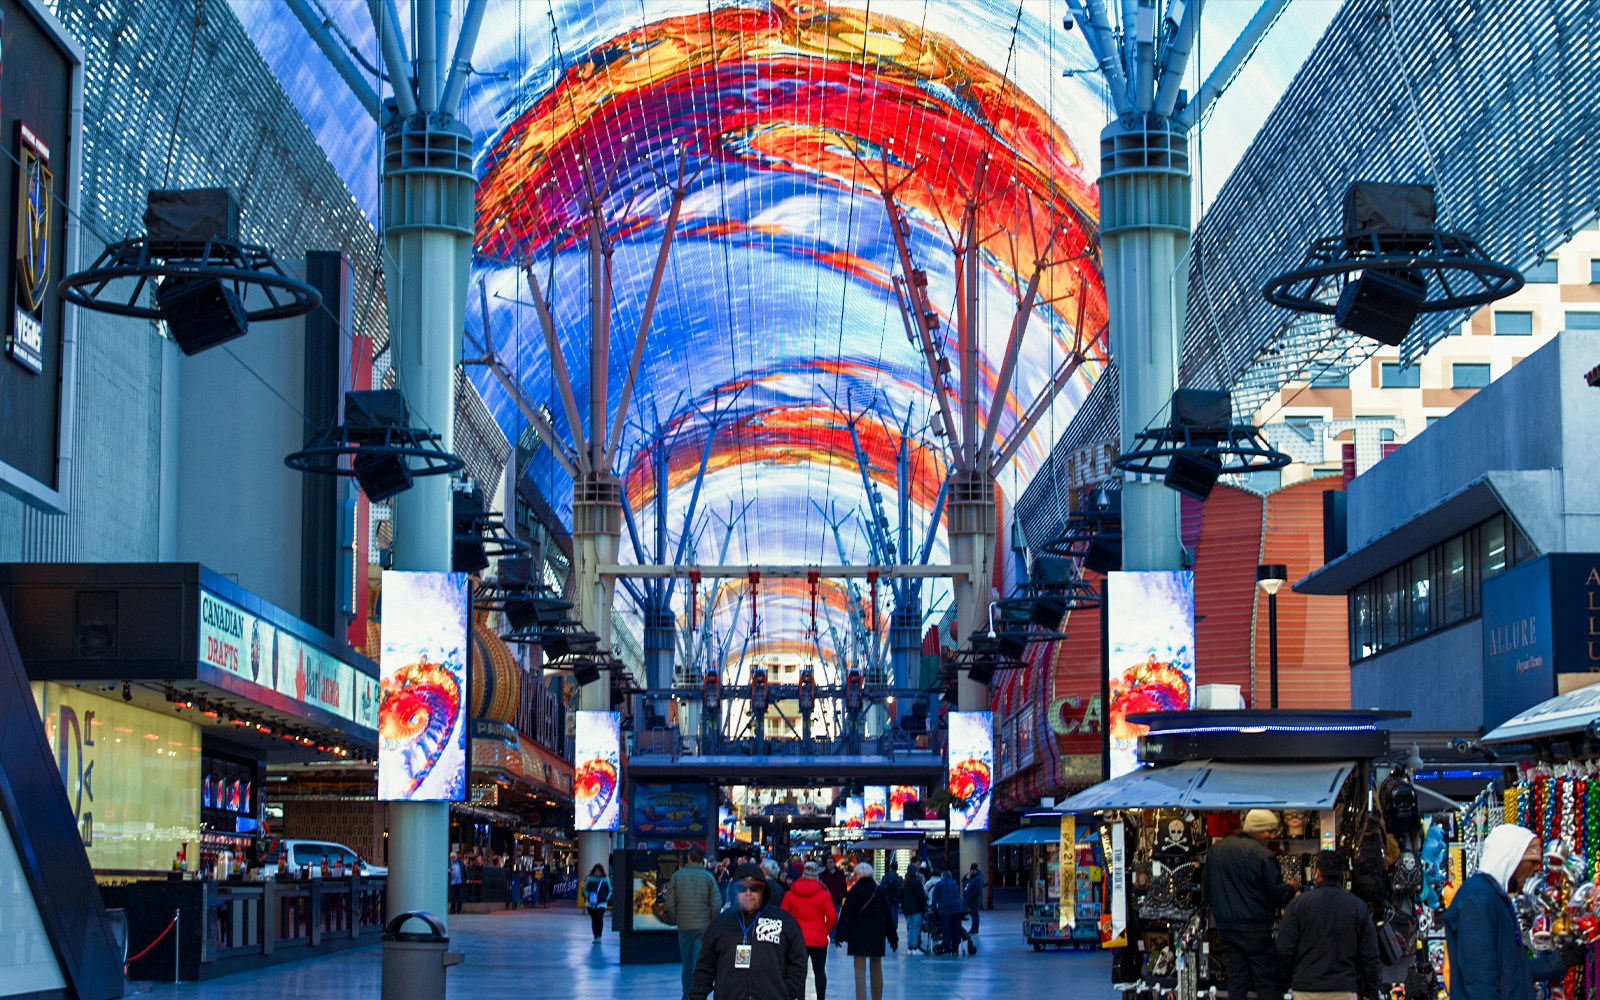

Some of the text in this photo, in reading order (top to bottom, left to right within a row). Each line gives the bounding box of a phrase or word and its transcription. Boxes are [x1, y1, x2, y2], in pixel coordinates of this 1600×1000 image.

[17, 310, 42, 353] VEGAS
[202, 597, 244, 639] CANADIAN
[1490, 615, 1536, 656] ALLURE
[207, 635, 239, 671] DRAFTS
[83, 710, 96, 848] BAR
[1063, 853, 1073, 866] 21
